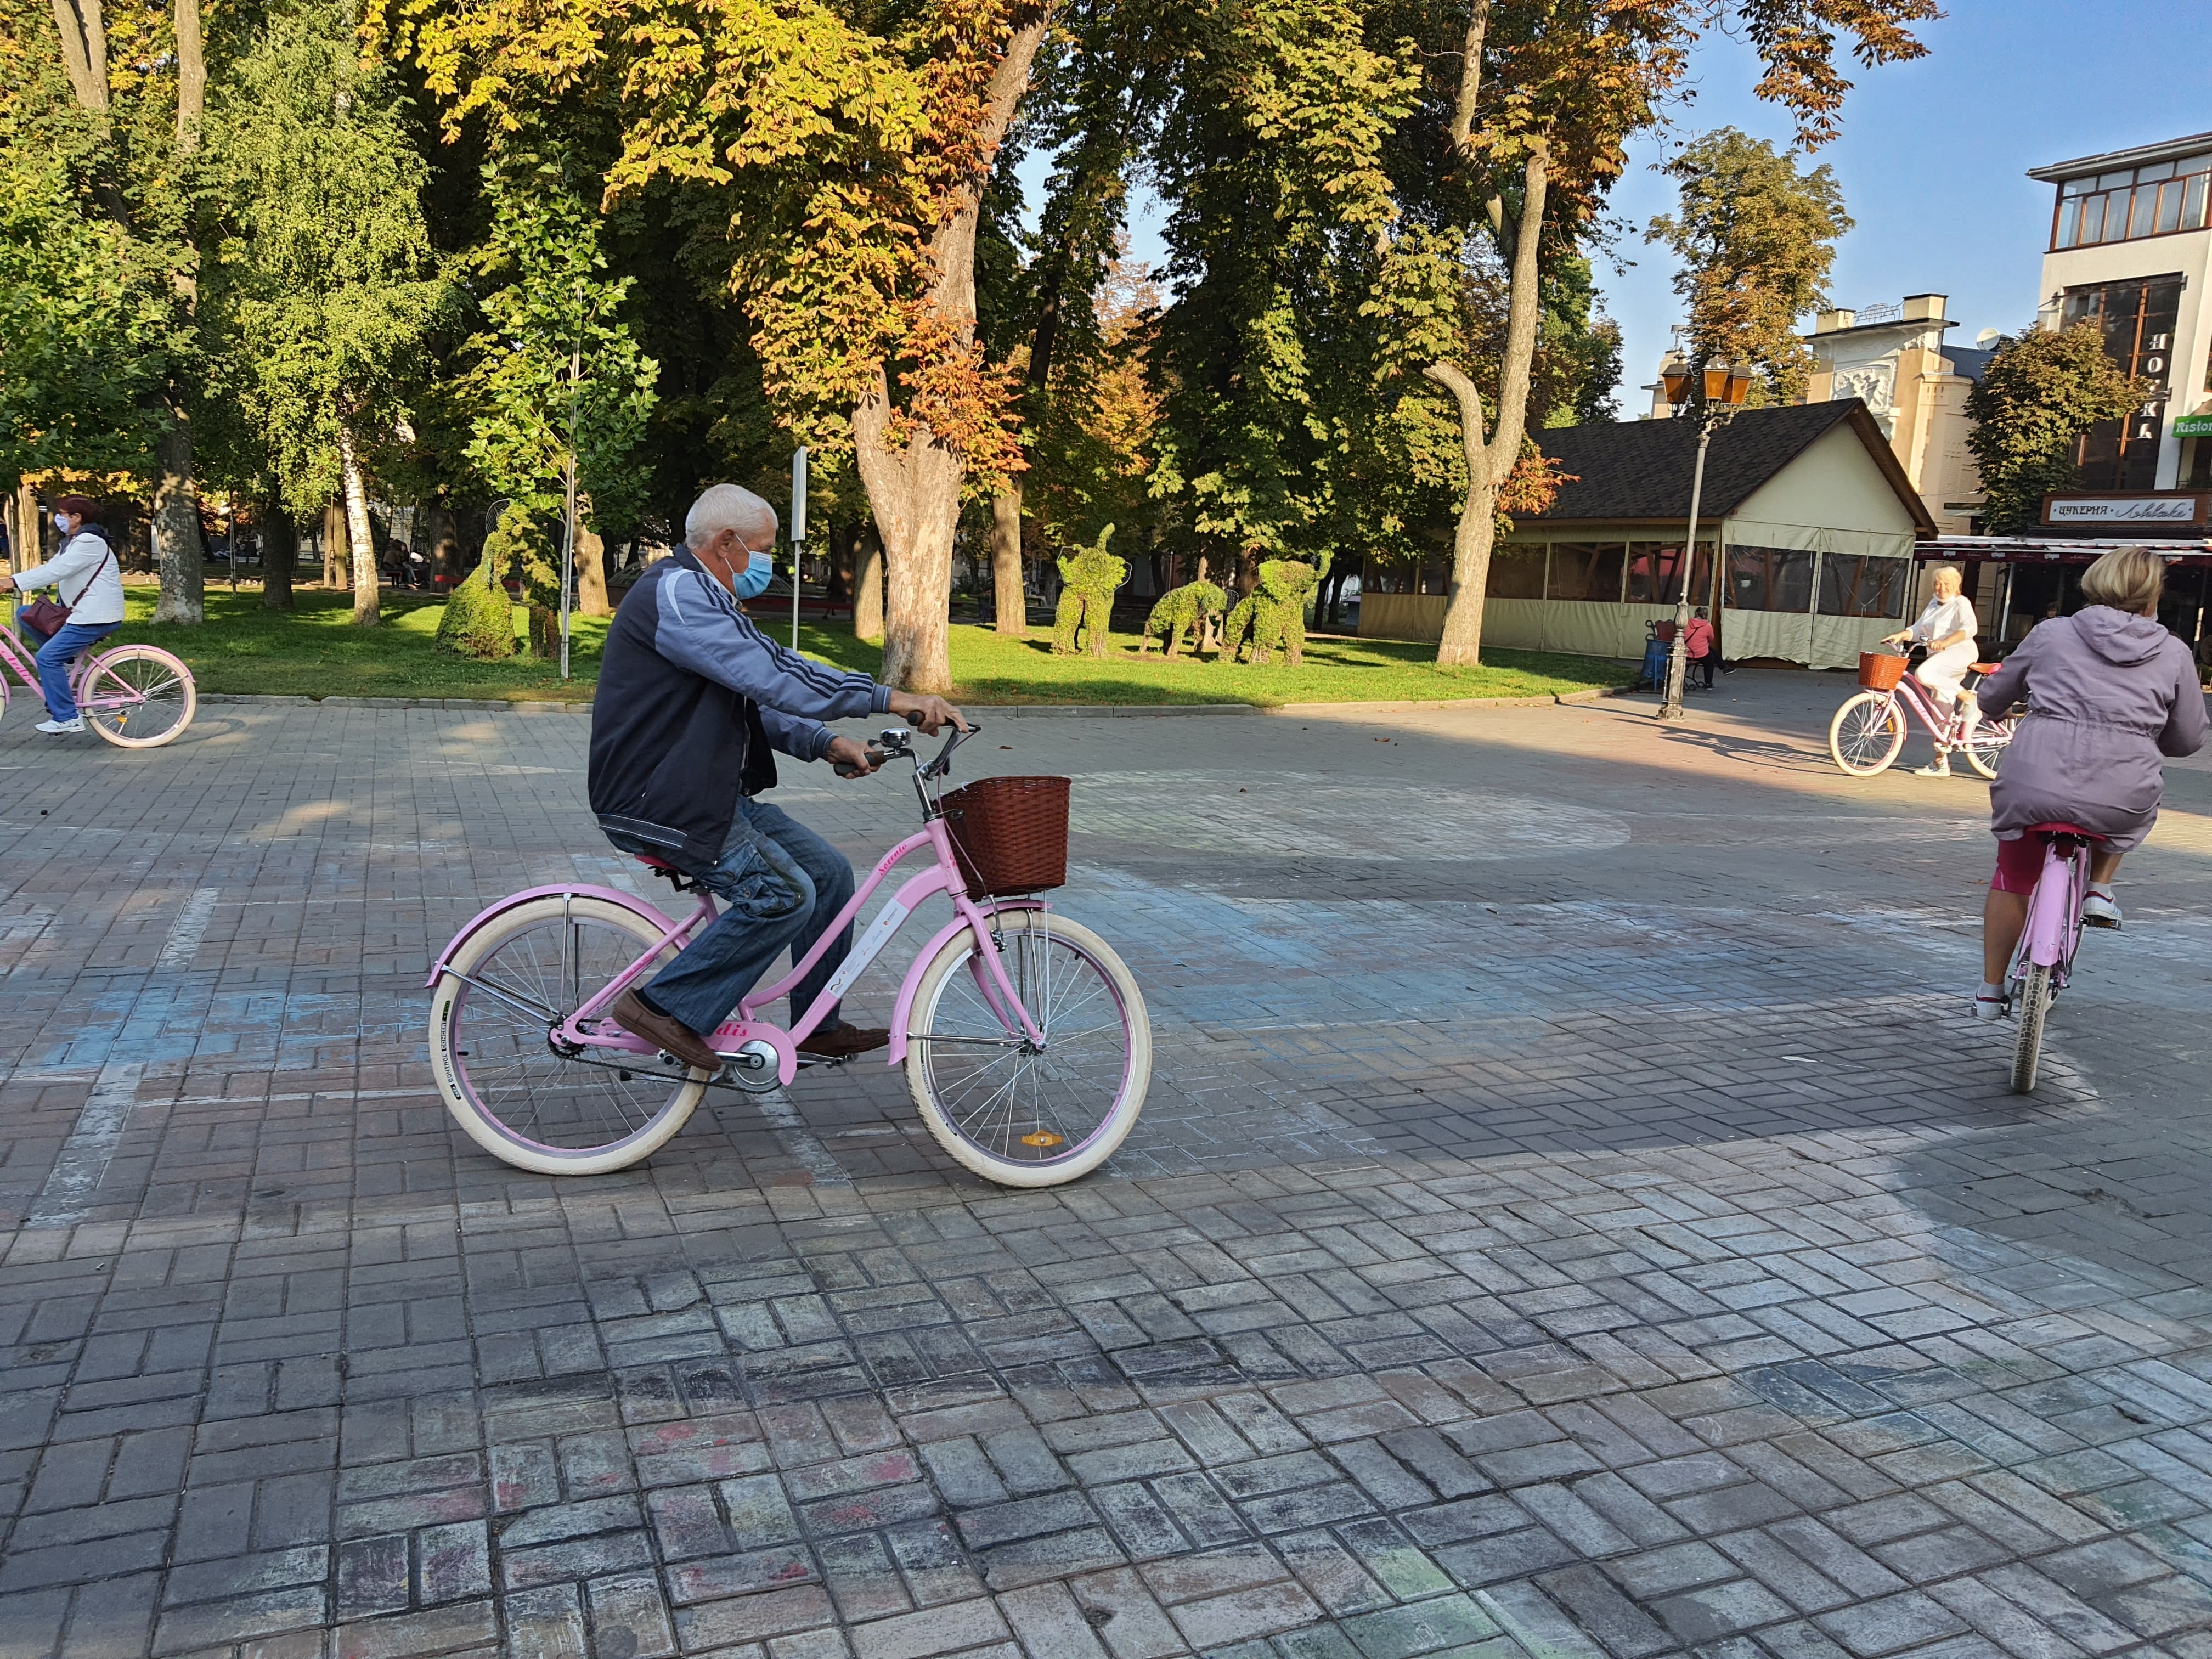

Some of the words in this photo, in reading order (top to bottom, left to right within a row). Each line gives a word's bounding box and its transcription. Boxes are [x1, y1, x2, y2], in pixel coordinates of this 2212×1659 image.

[2059, 505, 2108, 516] ЦУКЕРНЯ
[878, 843, 907, 876] Sorento
[716, 1023, 748, 1036] dis
